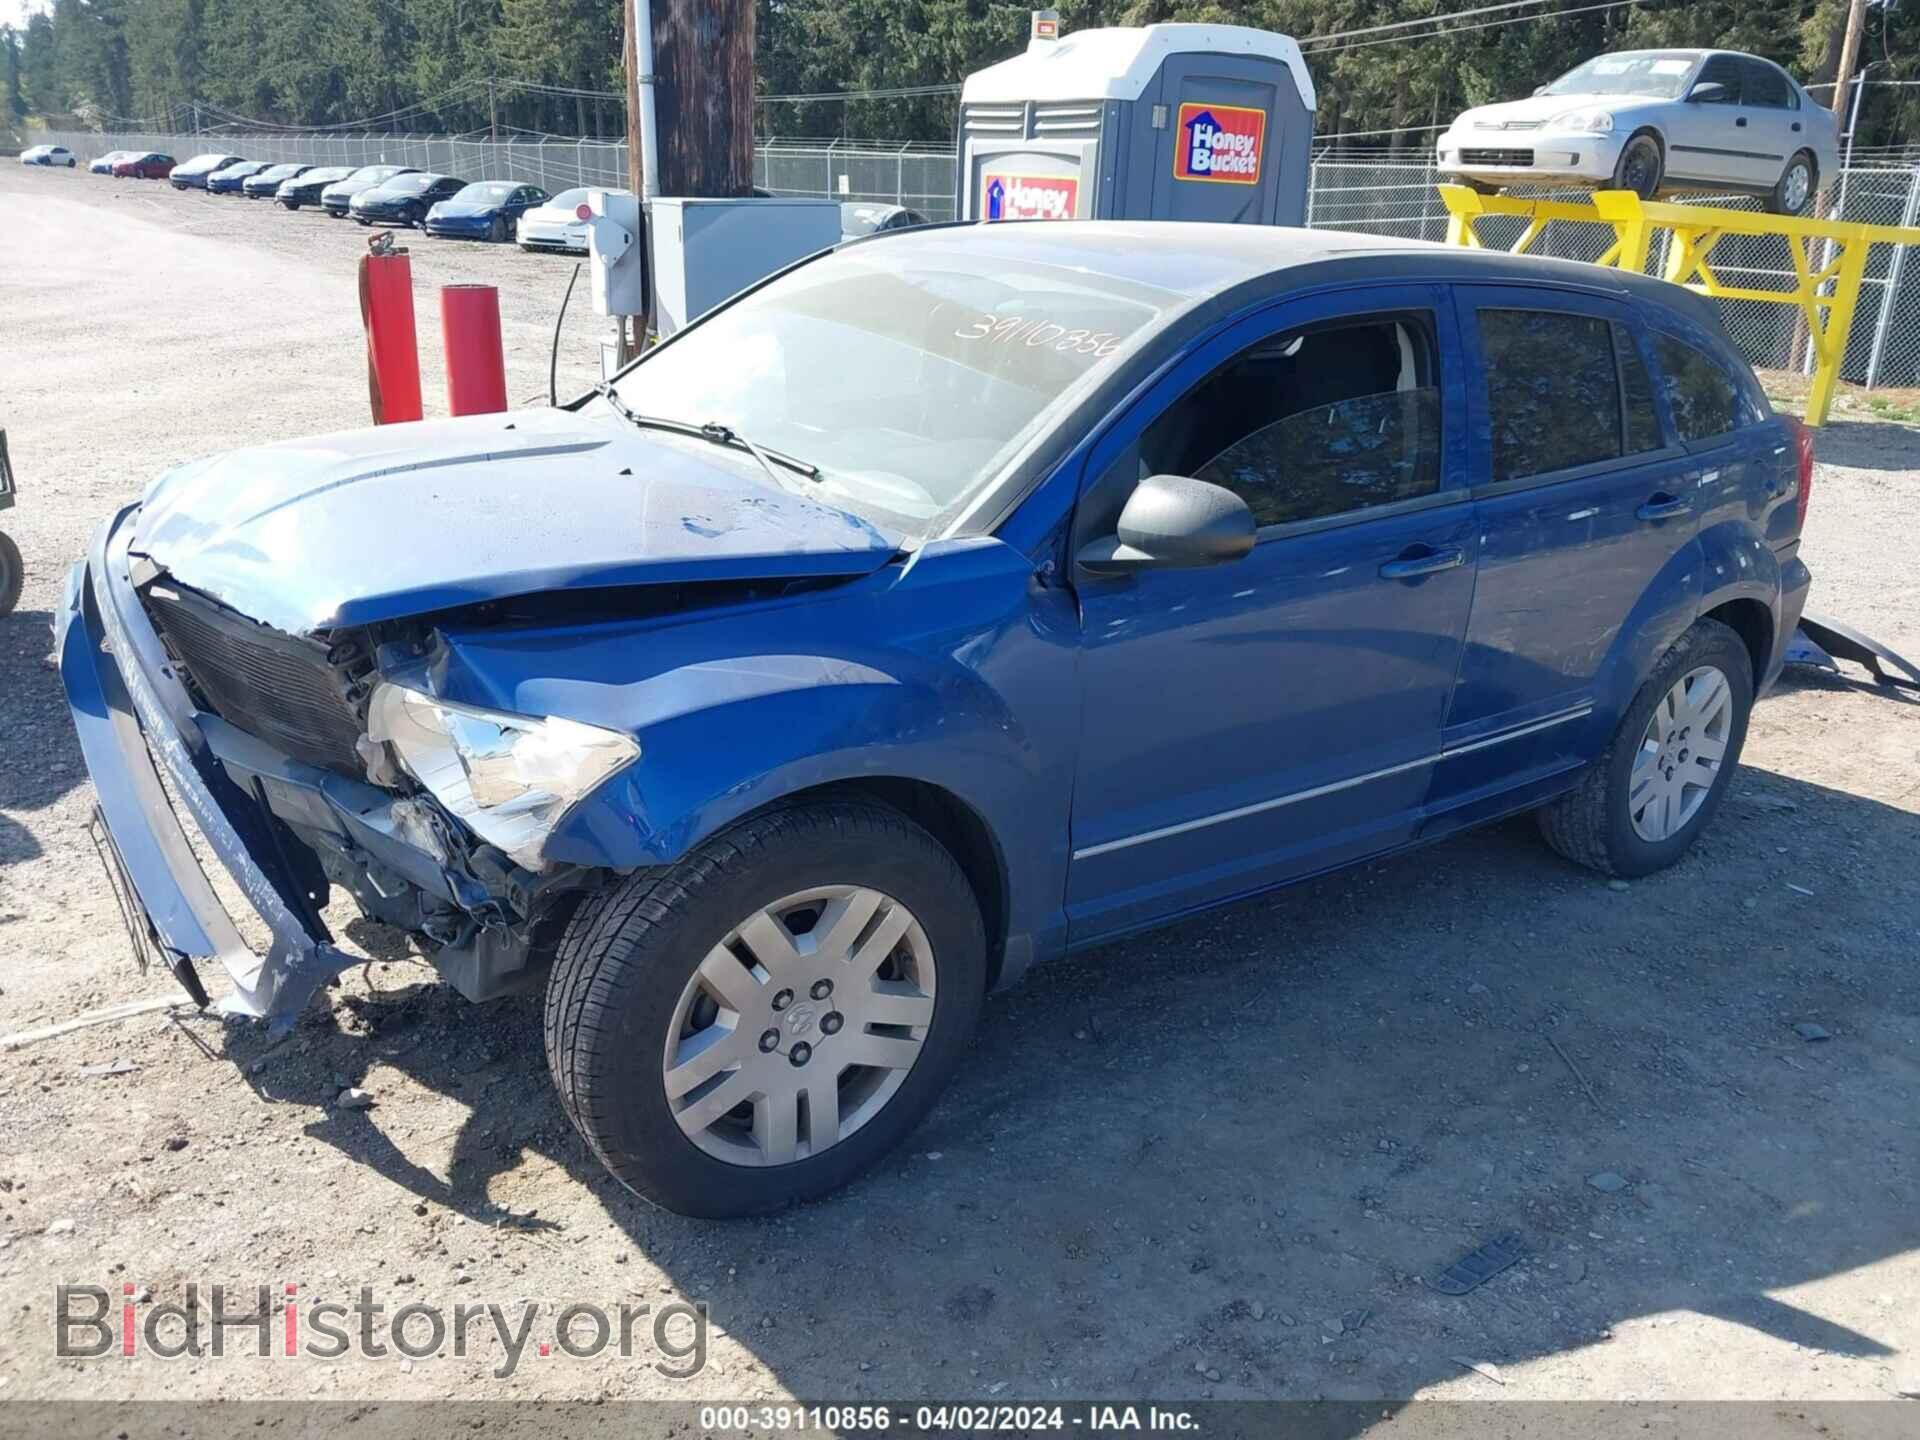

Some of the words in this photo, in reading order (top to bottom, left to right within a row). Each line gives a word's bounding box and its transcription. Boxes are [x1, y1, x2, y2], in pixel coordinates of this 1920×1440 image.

[1193, 123, 1255, 156] Honey
[1191, 148, 1257, 174] Bucket
[1005, 174, 1069, 217] Honey
[954, 314, 1122, 357] 39110856
